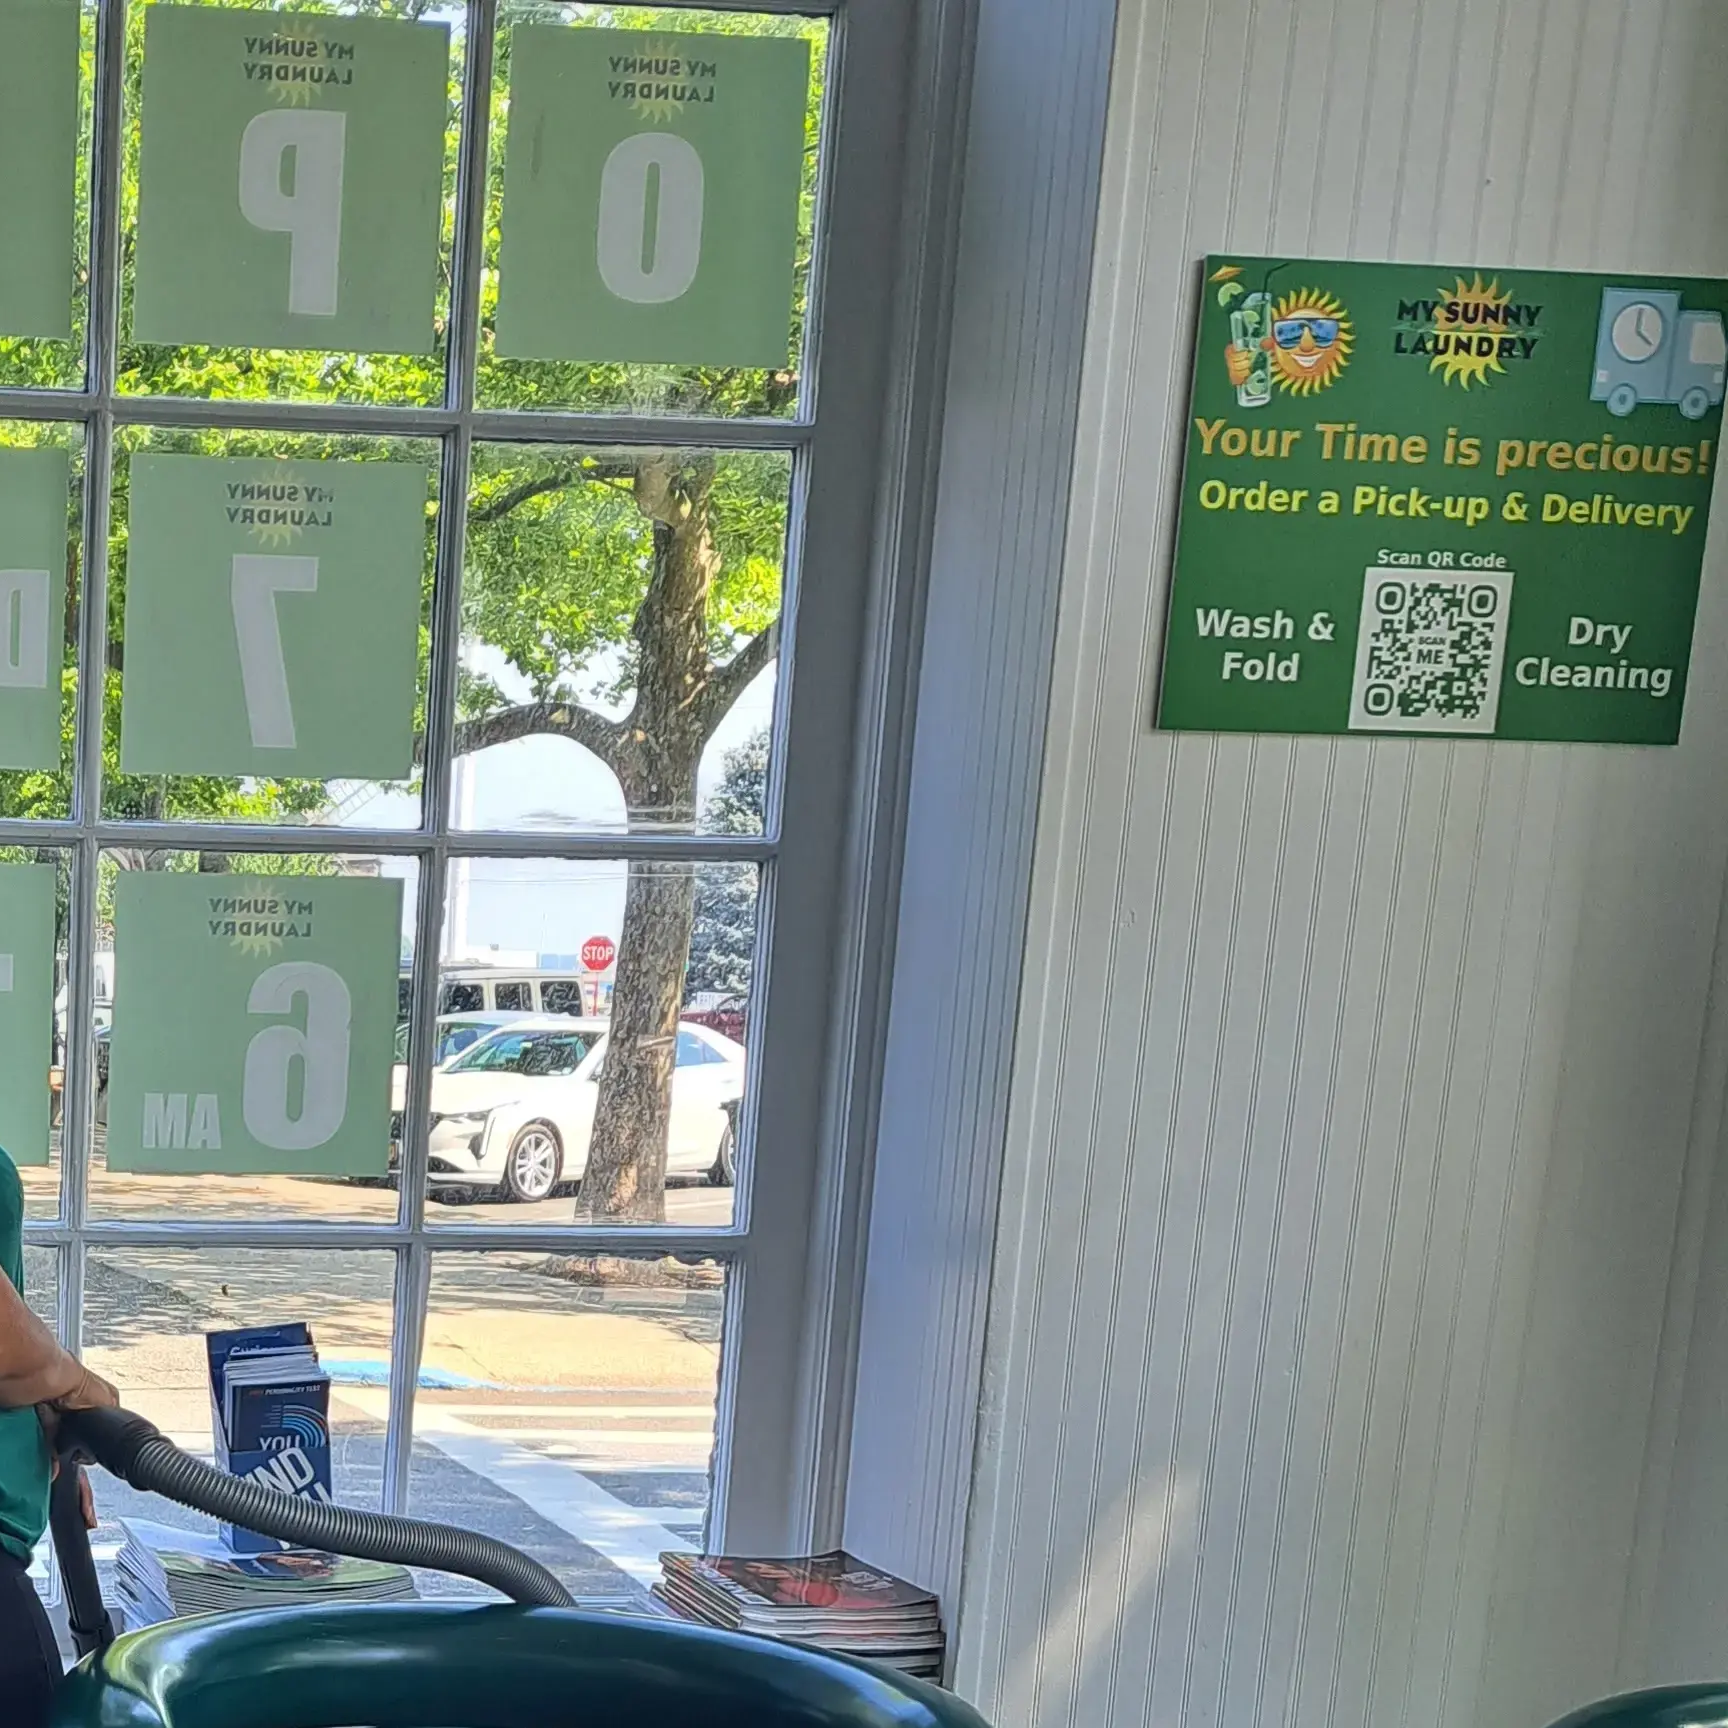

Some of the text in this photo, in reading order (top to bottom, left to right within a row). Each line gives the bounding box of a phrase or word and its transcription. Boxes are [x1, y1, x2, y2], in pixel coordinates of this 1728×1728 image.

[1396, 299, 1544, 327] MY SUNNY
[1393, 332, 1539, 360] LAUNDRY
[1194, 418, 1713, 477] Your Time is precious!
[1199, 479, 1695, 536] Order a Pick-up & Delivery
[1376, 548, 1508, 569] Scan QR Code
[1195, 607, 1336, 642] Wash &
[1567, 617, 1633, 655] Dry
[1417, 636, 1447, 646] SCAN
[1221, 651, 1300, 682] Fold
[1416, 649, 1445, 665] ME
[1514, 656, 1673, 697] Cleaning
[583, 945, 614, 961] STOP
[259, 1434, 301, 1452] YOU
